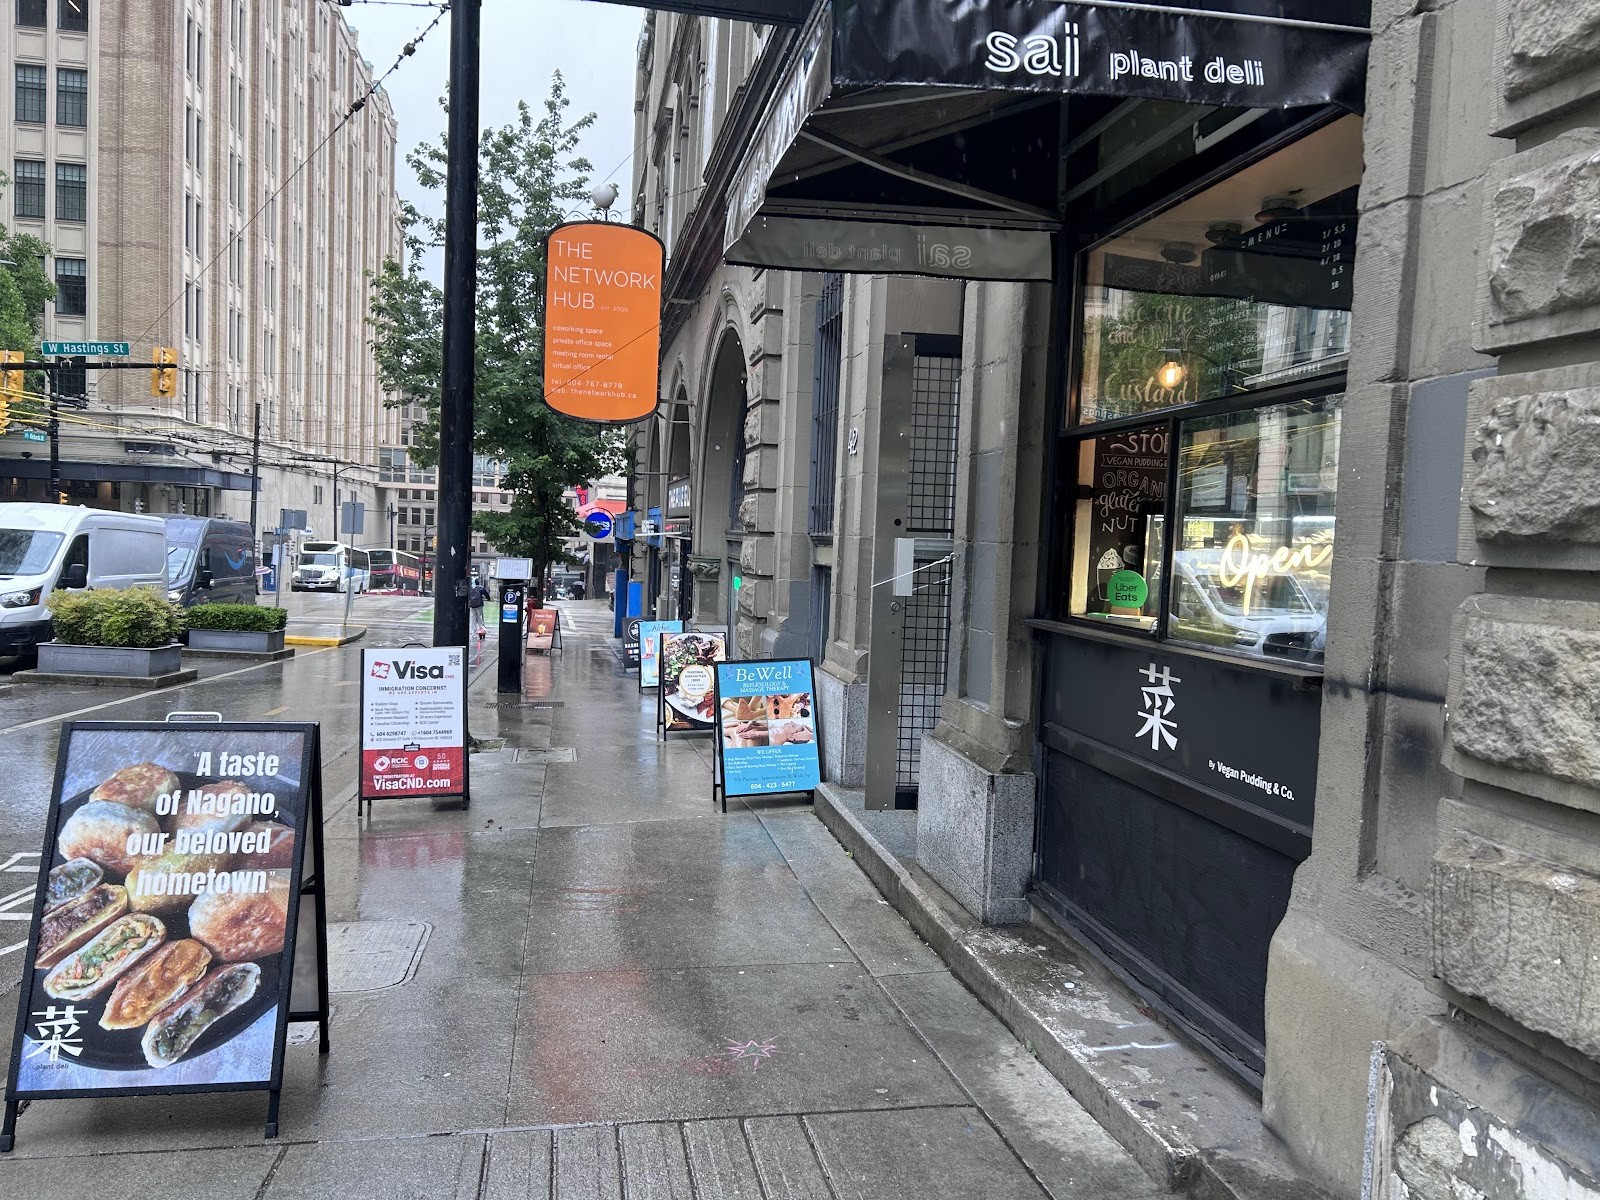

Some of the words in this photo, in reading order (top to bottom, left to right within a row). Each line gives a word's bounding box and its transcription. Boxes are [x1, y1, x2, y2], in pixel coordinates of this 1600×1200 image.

[984, 21, 1080, 77] sai
[1109, 50, 1194, 82] plant
[1203, 56, 1265, 87] deli
[555, 240, 593, 260] THE
[554, 265, 656, 290] NETWORK
[553, 291, 595, 310] HUB
[552, 325, 584, 334] coworking
[48, 344, 58, 353] W
[63, 343, 109, 354] Hastings
[113, 343, 124, 353] St
[552, 349, 578, 359] meeting
[551, 362, 572, 370] virtual
[573, 363, 591, 371] office
[1106, 456, 1134, 467] VEGAN
[1101, 515, 1139, 533] NUT
[1219, 533, 1333, 616] Open
[1115, 582, 1138, 592] Uber
[1115, 592, 1138, 602] Eats
[391, 660, 444, 680] Visa
[1135, 662, 1182, 751] 菜
[218, 751, 280, 777] taste
[373, 777, 451, 791] VisaCND.com
[1216, 761, 1239, 780] Vegan
[1239, 769, 1273, 795] Pudding
[1272, 782, 1280, 796] &
[1280, 785, 1295, 801] Co.
[155, 789, 182, 816] of
[186, 789, 280, 818] Nagano,
[125, 832, 170, 856] our
[174, 827, 272, 855] beloved
[25, 1005, 89, 1062] 菜
